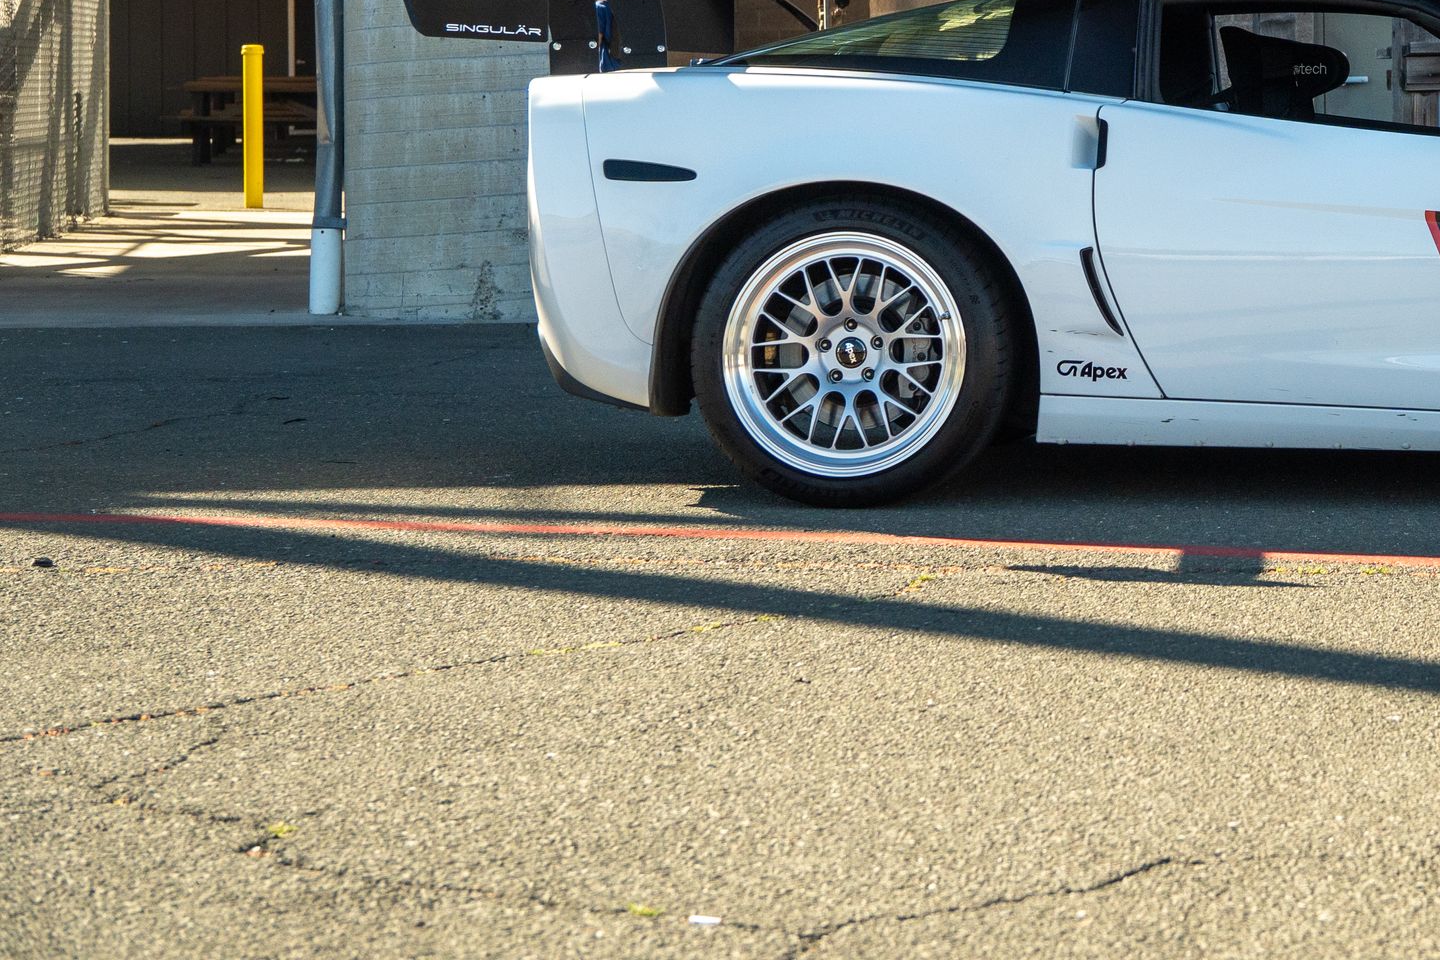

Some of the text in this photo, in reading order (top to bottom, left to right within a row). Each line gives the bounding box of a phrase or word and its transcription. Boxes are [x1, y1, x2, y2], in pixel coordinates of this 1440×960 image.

[445, 23, 543, 36] SINGULÄR
[844, 342, 858, 364] Apex
[1080, 361, 1128, 382] Apex
